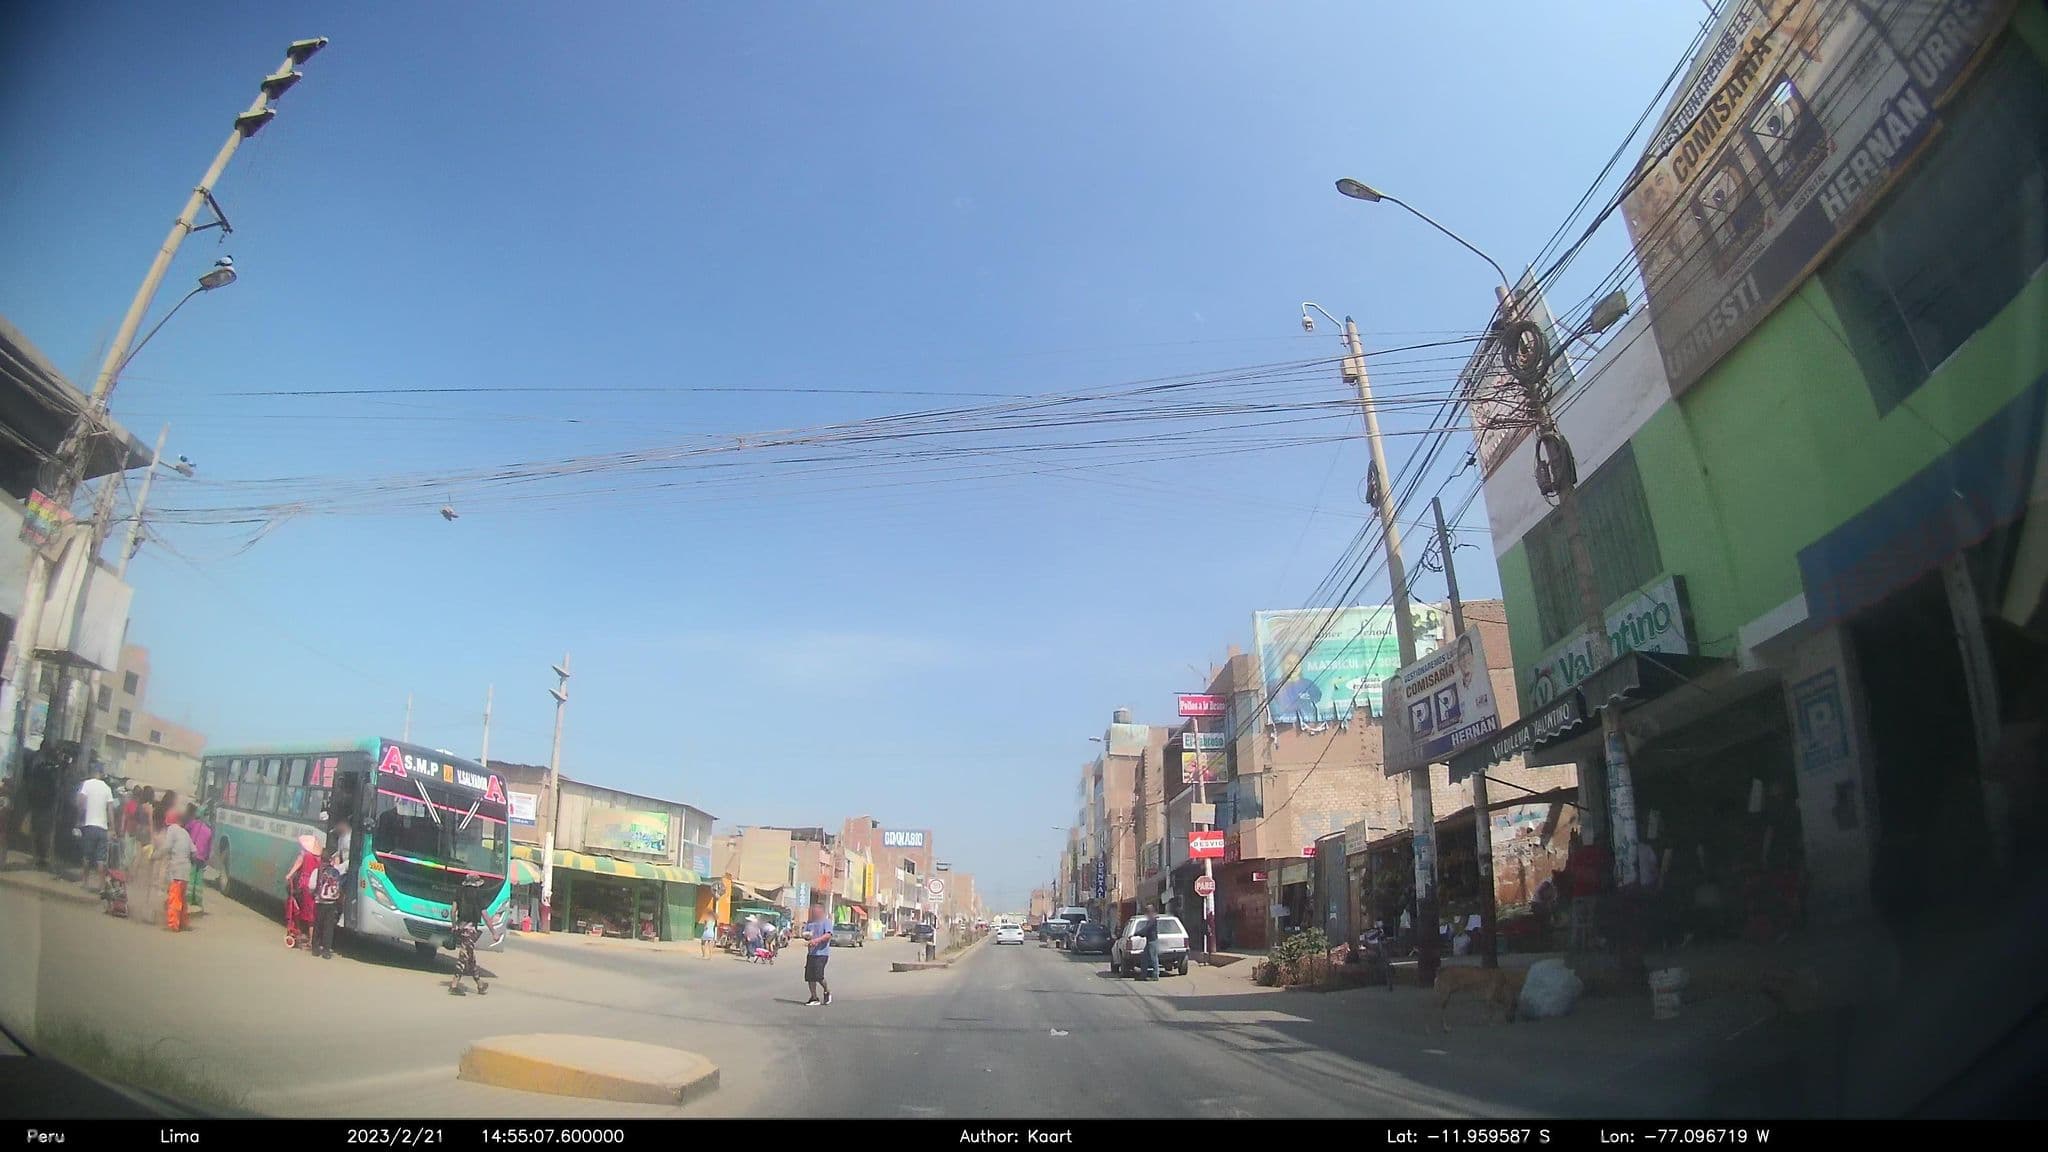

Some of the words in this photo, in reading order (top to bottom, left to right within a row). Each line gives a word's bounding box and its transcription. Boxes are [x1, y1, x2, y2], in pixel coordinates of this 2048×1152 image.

[1818, 87, 1929, 223] HERNÁN
[1558, 602, 1671, 684] Valntino
[1405, 663, 1455, 698] COMISARÍA
[1451, 716, 1497, 746] HERNÁN
[379, 746, 407, 778] A
[405, 755, 439, 777] S.M.P
[485, 775, 507, 804] A
[1193, 840, 1224, 848] DESVIO
[1197, 881, 1215, 890] PARE
